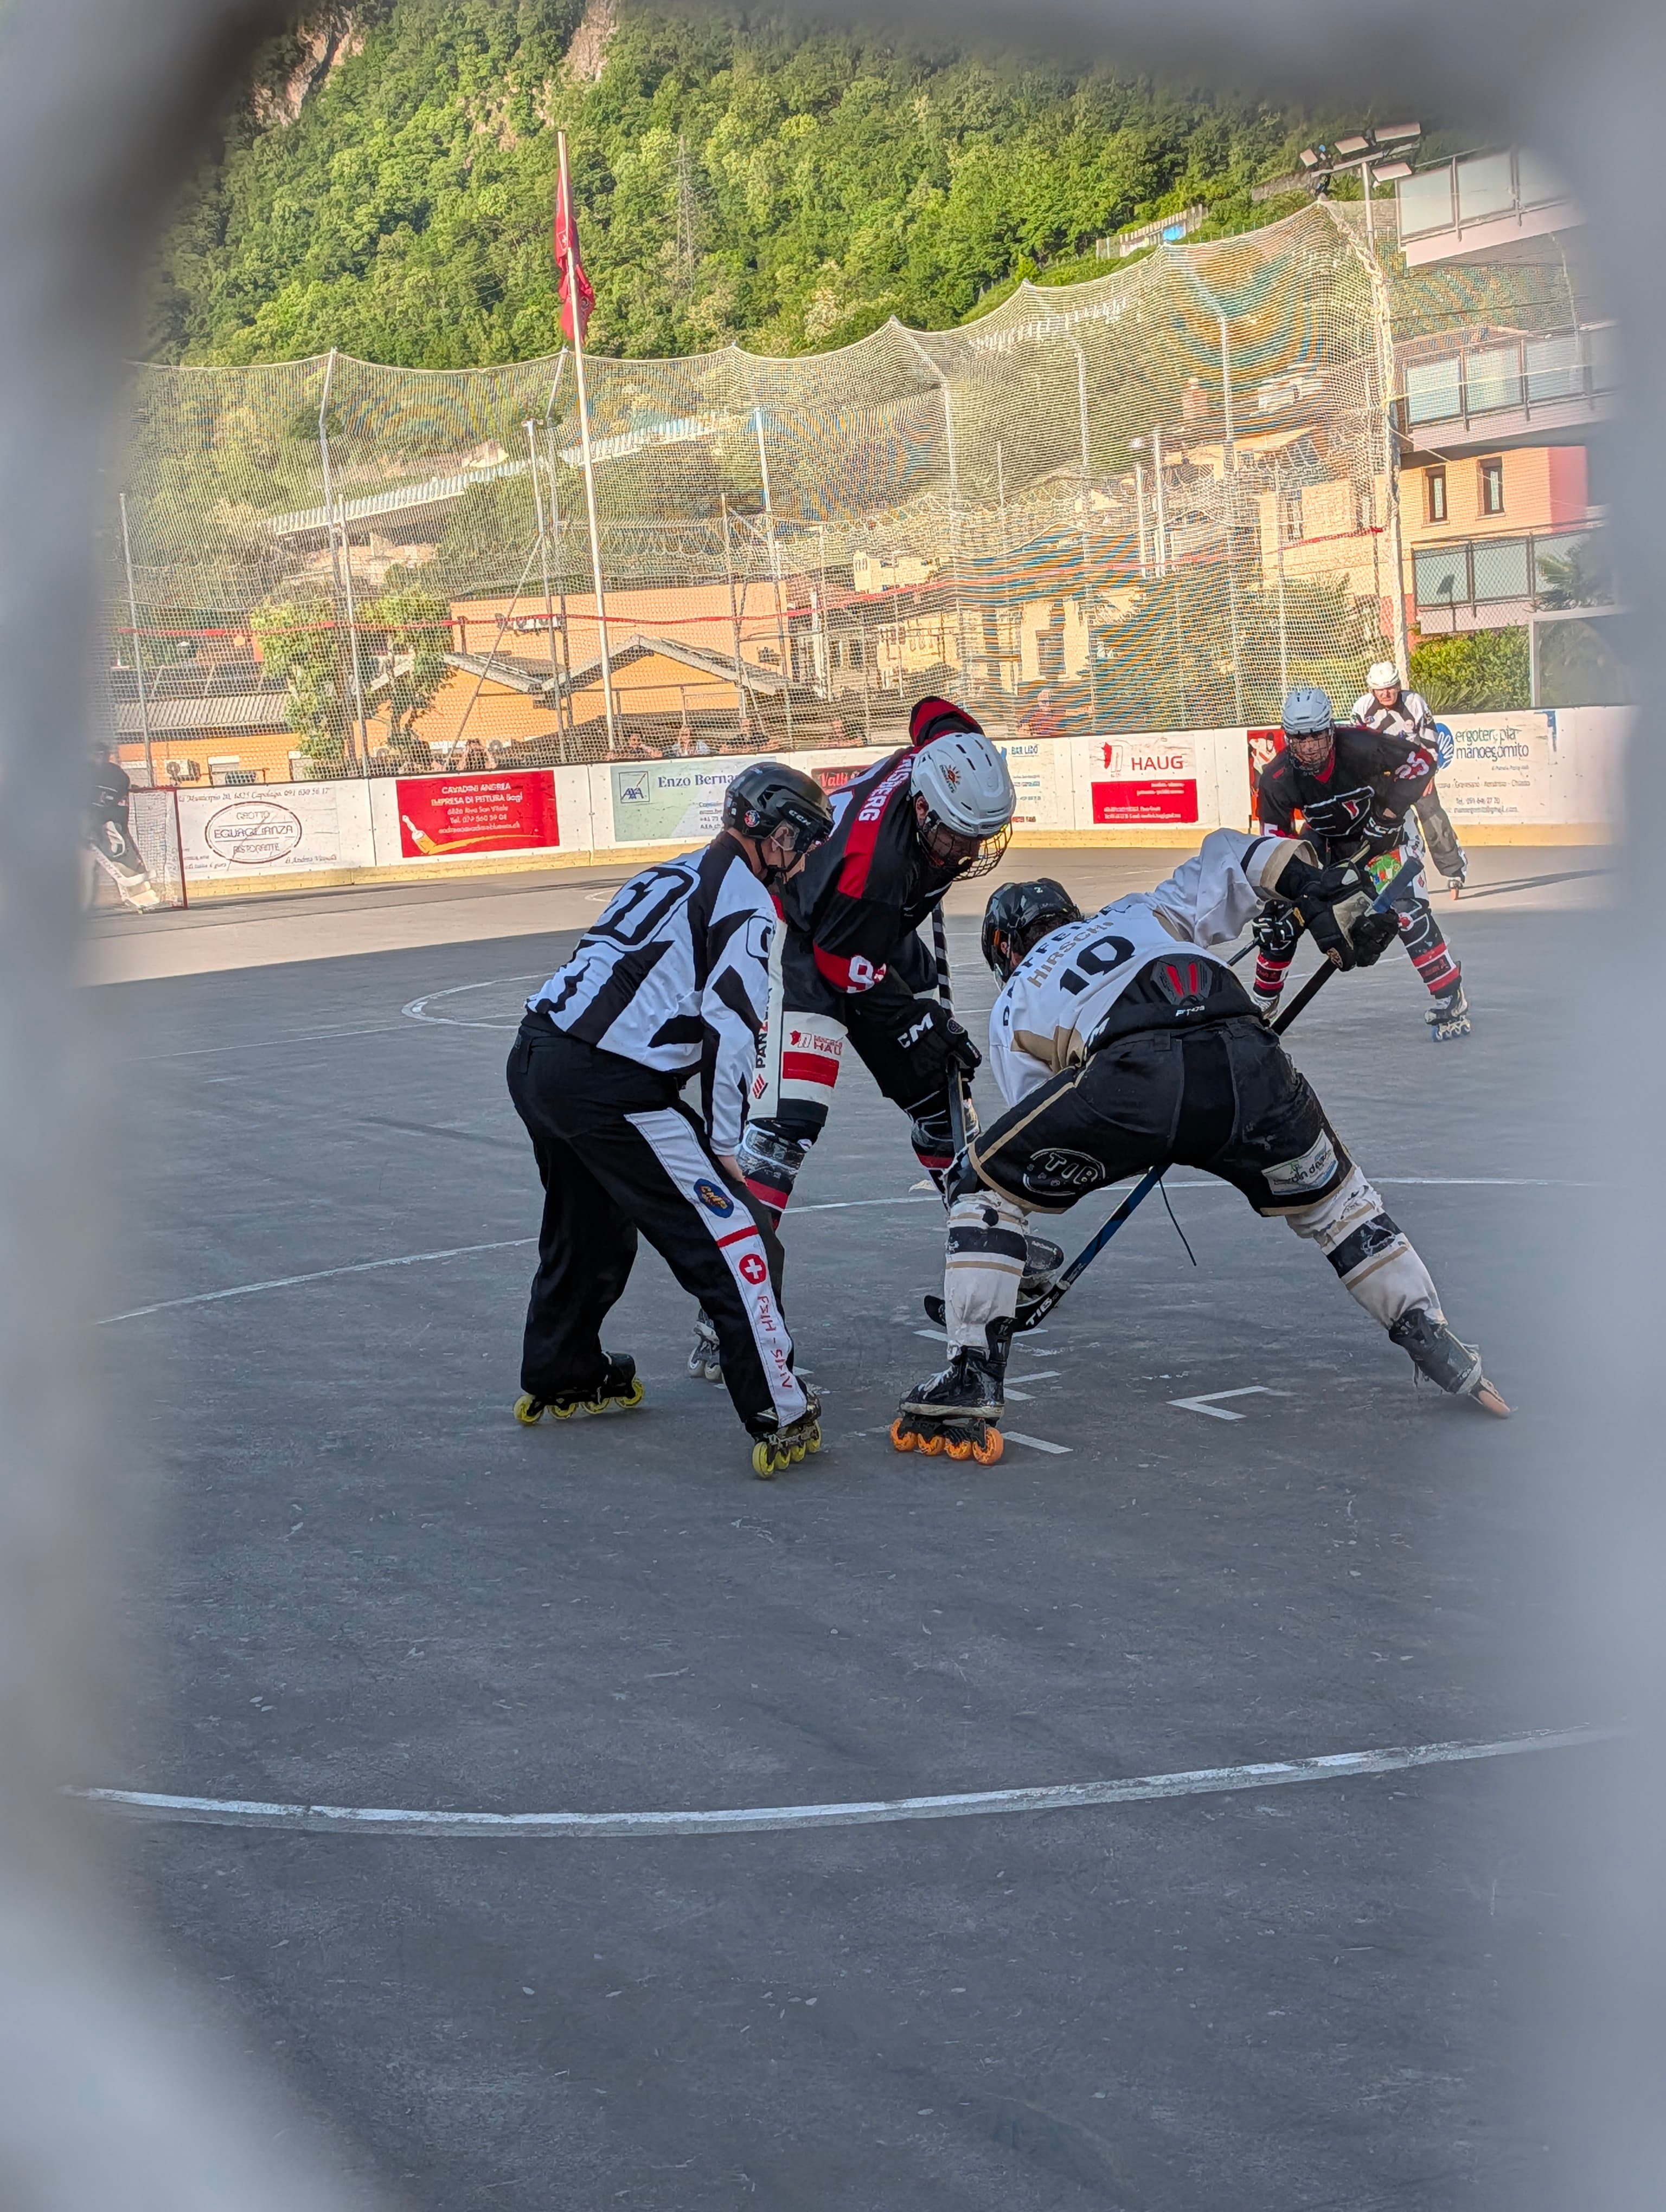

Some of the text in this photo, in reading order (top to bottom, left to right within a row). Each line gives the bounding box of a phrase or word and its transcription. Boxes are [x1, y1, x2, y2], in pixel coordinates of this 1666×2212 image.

[1131, 755, 1183, 771] HAUG
[658, 776, 691, 788] Enzo
[620, 787, 644, 800] AXA
[1059, 935, 1137, 995] 10
